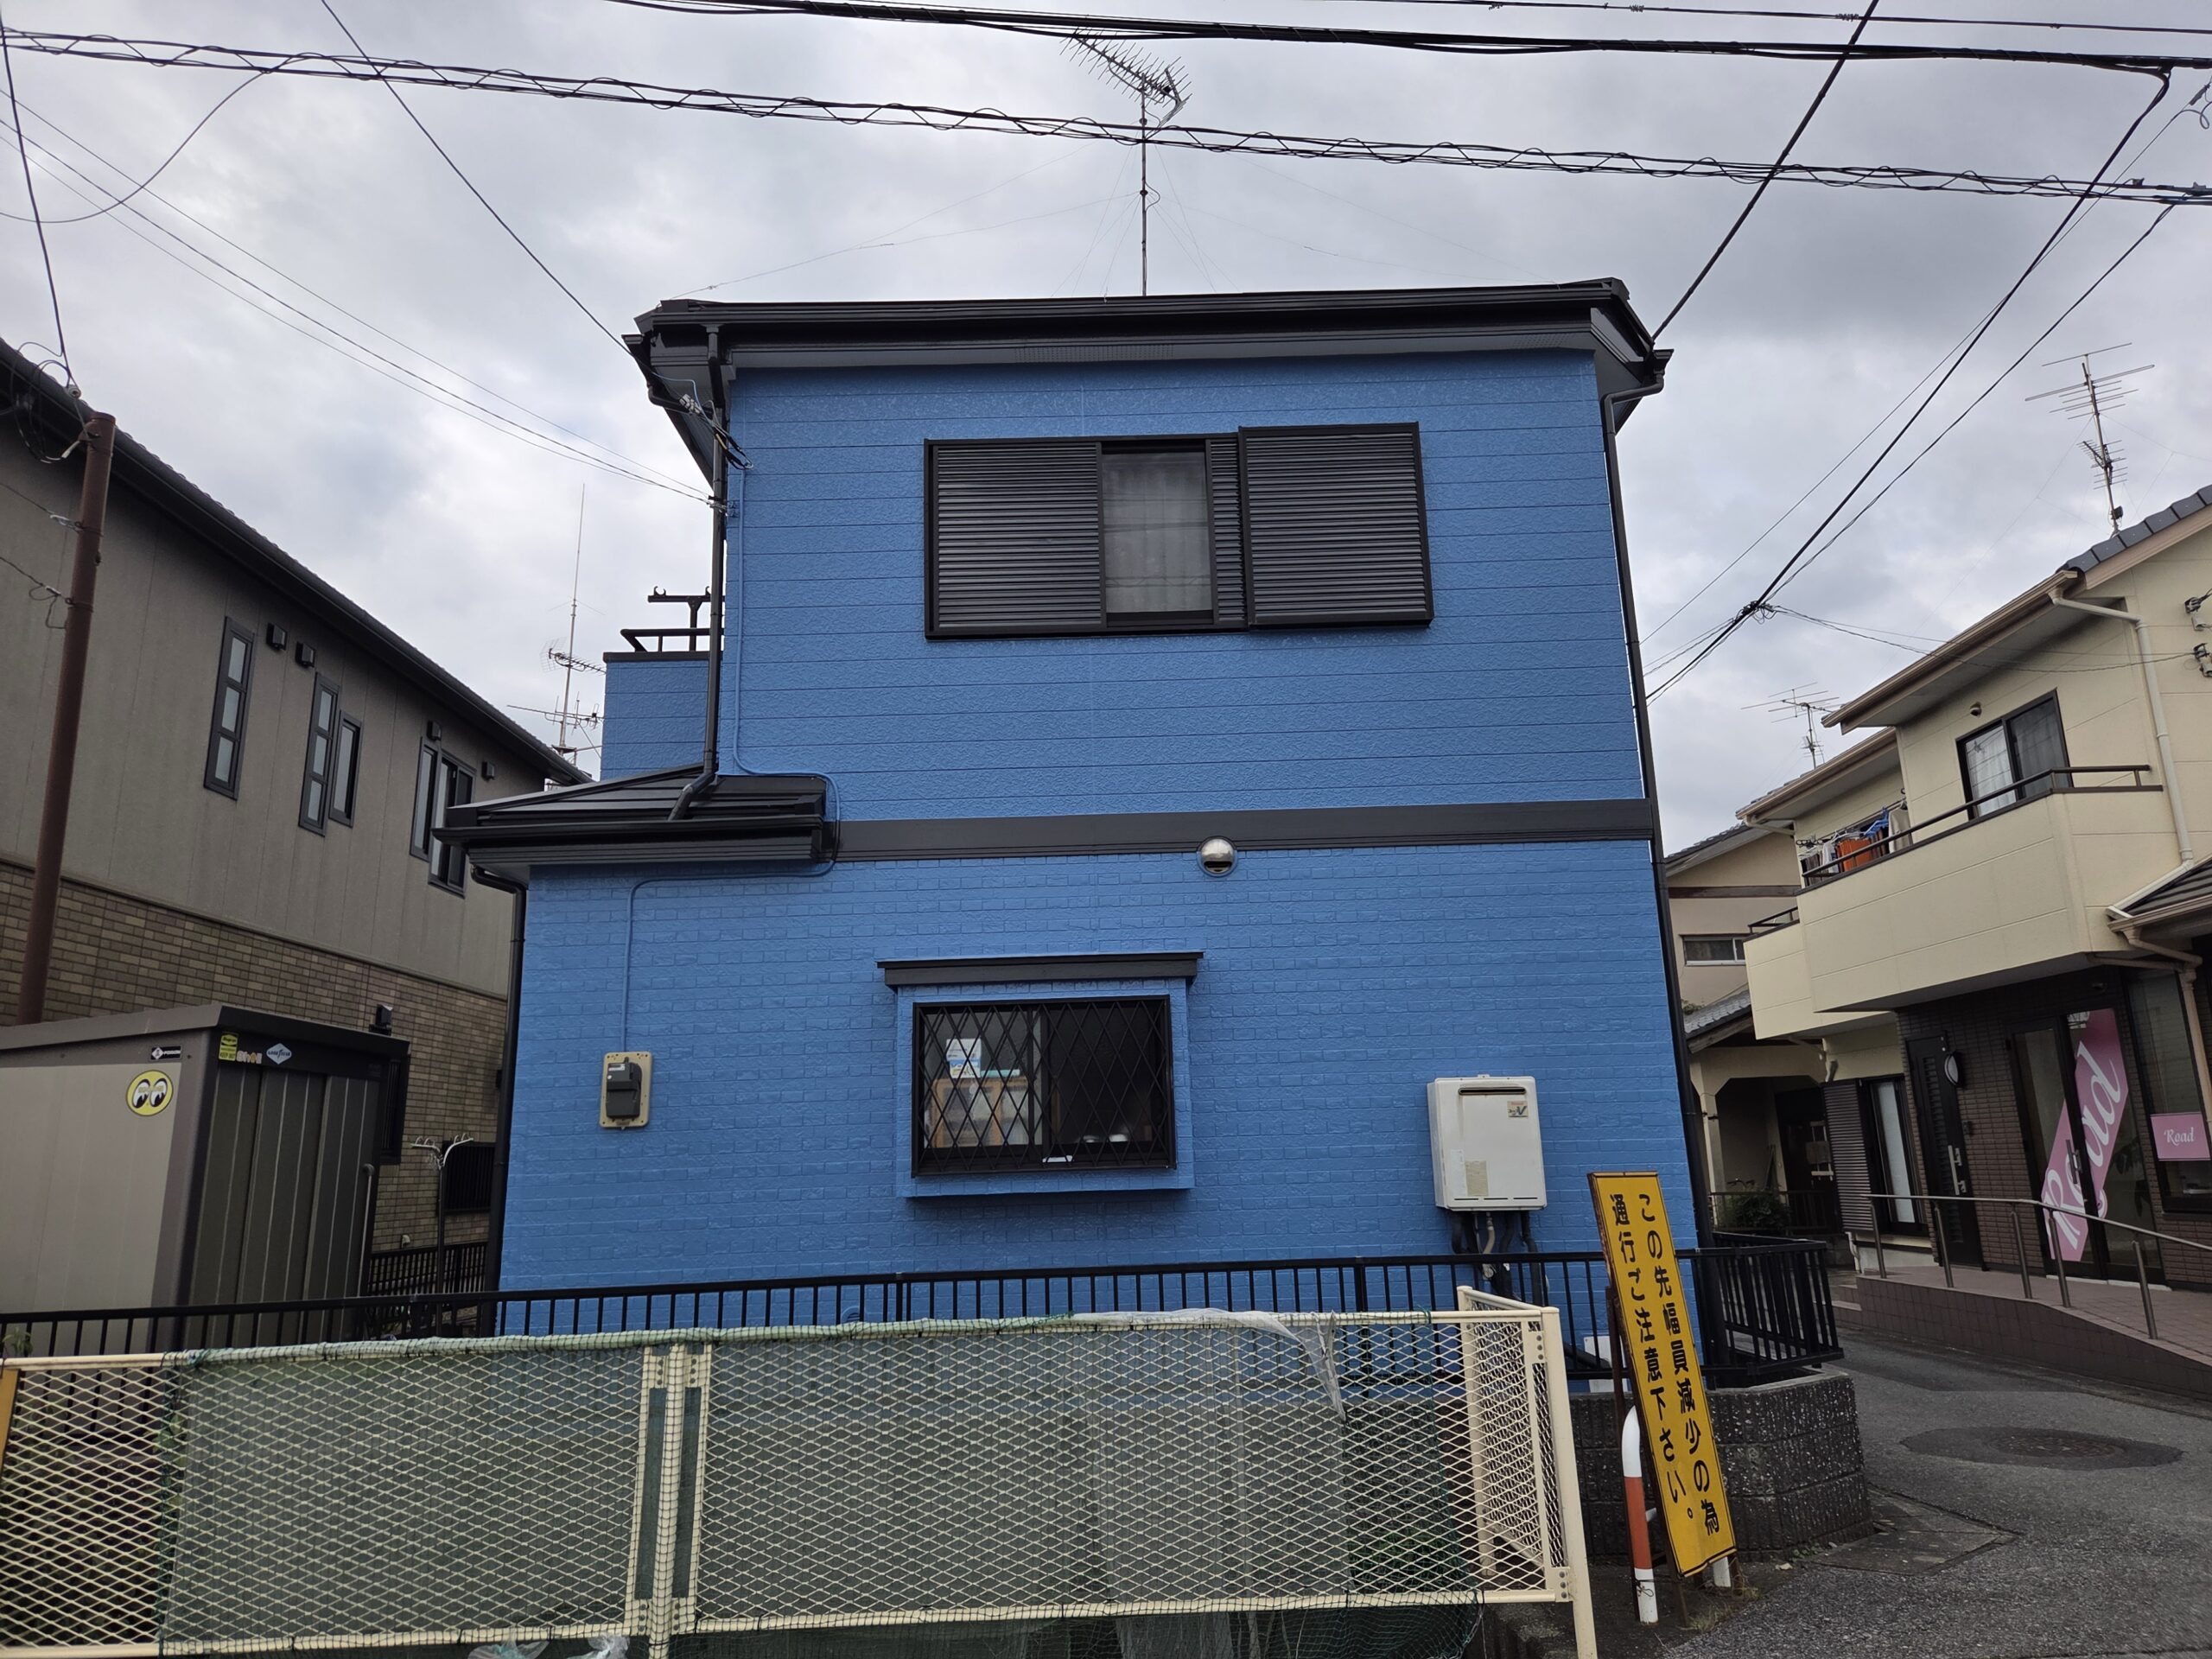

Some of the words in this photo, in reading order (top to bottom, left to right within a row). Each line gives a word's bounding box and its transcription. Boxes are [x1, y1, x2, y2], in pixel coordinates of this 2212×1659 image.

[2164, 1126, 2195, 1146] Road
[1610, 1193, 1694, 1519] 通行ご注意下さい。
[1638, 1193, 1719, 1536] この先幅員減少の為
